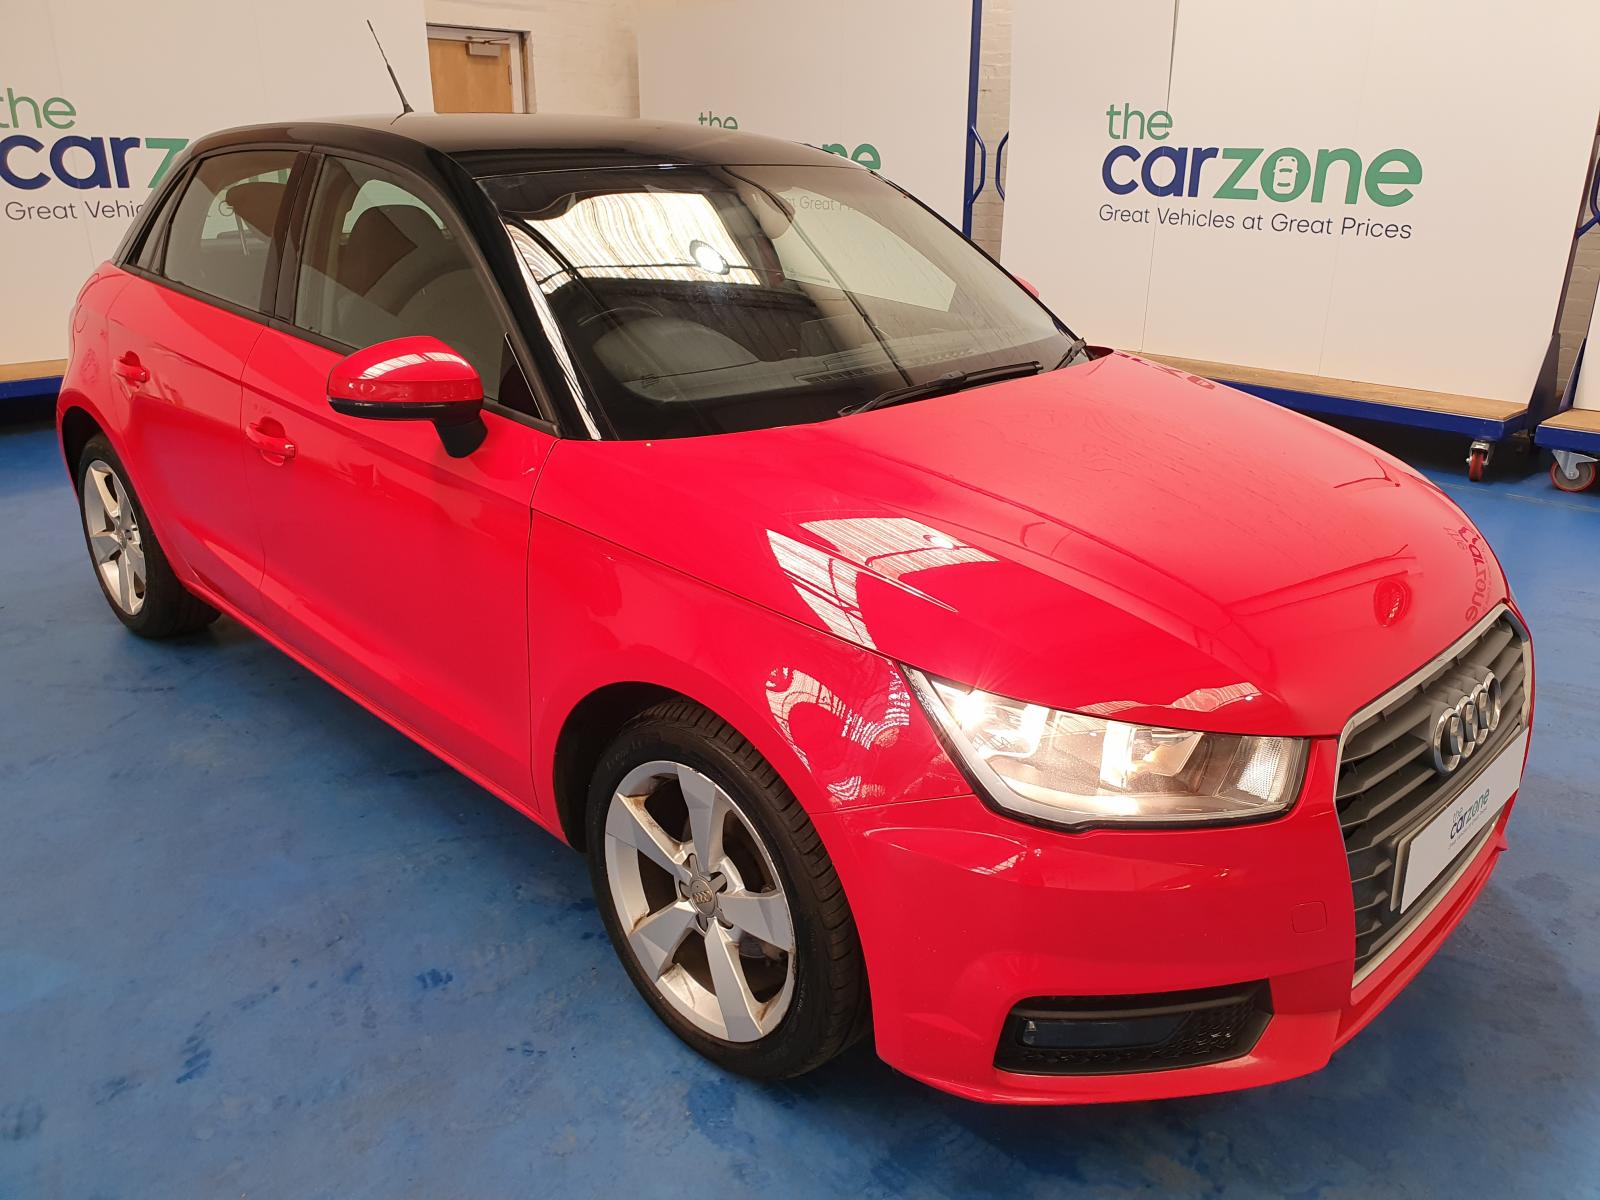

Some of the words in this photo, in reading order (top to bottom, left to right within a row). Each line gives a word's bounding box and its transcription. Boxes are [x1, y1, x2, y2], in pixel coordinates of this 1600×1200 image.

[1106, 102, 1173, 141] the
[1101, 145, 1423, 208] carzone
[5, 201, 78, 220] Great
[1099, 203, 1150, 224] Great
[1157, 207, 1236, 229] Vehicles
[1242, 214, 1264, 231] at
[1271, 212, 1333, 235] Great
[1341, 216, 1413, 240] Prices
[1450, 788, 1490, 840] carzone
